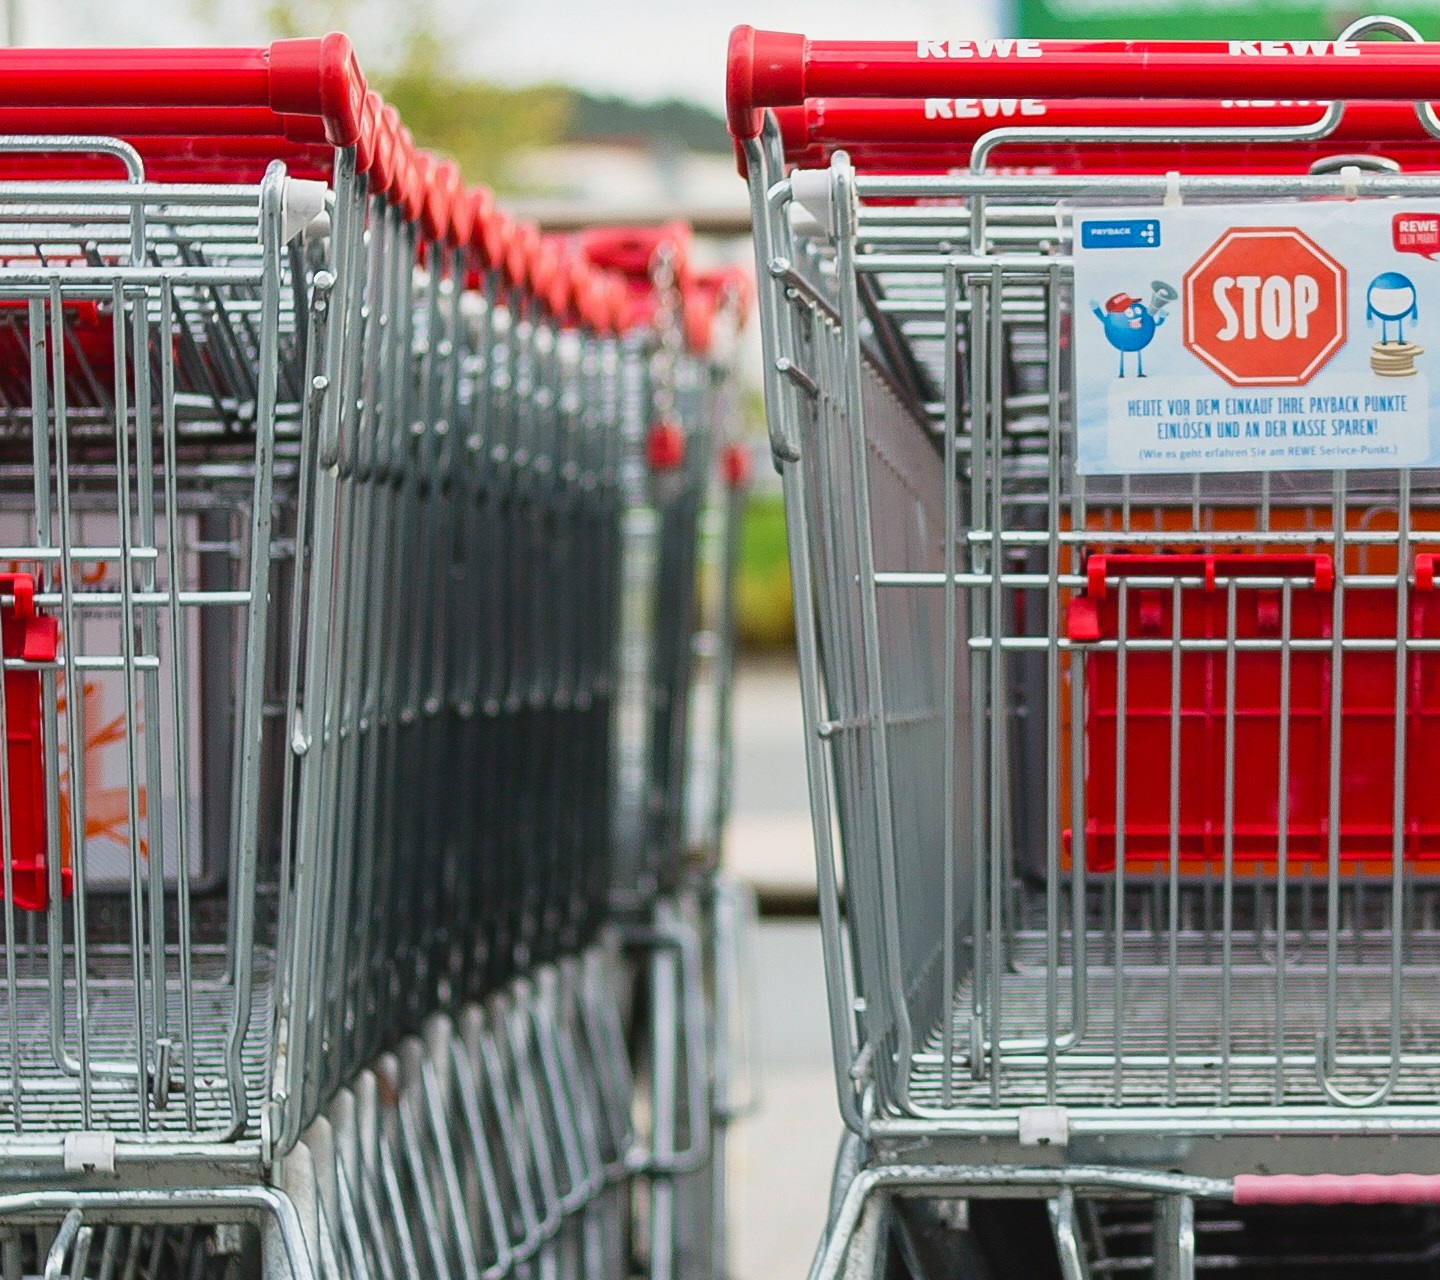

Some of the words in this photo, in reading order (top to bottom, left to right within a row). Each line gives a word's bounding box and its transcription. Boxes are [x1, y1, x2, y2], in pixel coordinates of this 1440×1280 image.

[1399, 220, 1438, 232] REWE
[1212, 274, 1320, 341] STOP
[1127, 398, 1163, 417] HEUTE
[1167, 398, 1190, 417] VOR
[1195, 398, 1220, 416] DEM
[1225, 397, 1274, 416] EINKAUF
[1277, 396, 1304, 415] IHRE
[1309, 395, 1360, 414] PAYBACK
[1364, 394, 1408, 413] PUNKTE
[1157, 419, 1212, 440] EINLÖSEN
[1216, 420, 1240, 439] UND
[1244, 420, 1260, 438] AN
[1264, 419, 1287, 438] DER
[1291, 419, 1327, 437] KASSE
[1331, 418, 1379, 437] SPAREN!
[1138, 448, 1163, 461] (Wie
[1165, 449, 1177, 460] es
[1179, 448, 1203, 461] geht
[1205, 446, 1249, 459] erfahren
[1251, 446, 1267, 458] Sie
[1269, 447, 1285, 457] am
[1287, 445, 1316, 457] REWE
